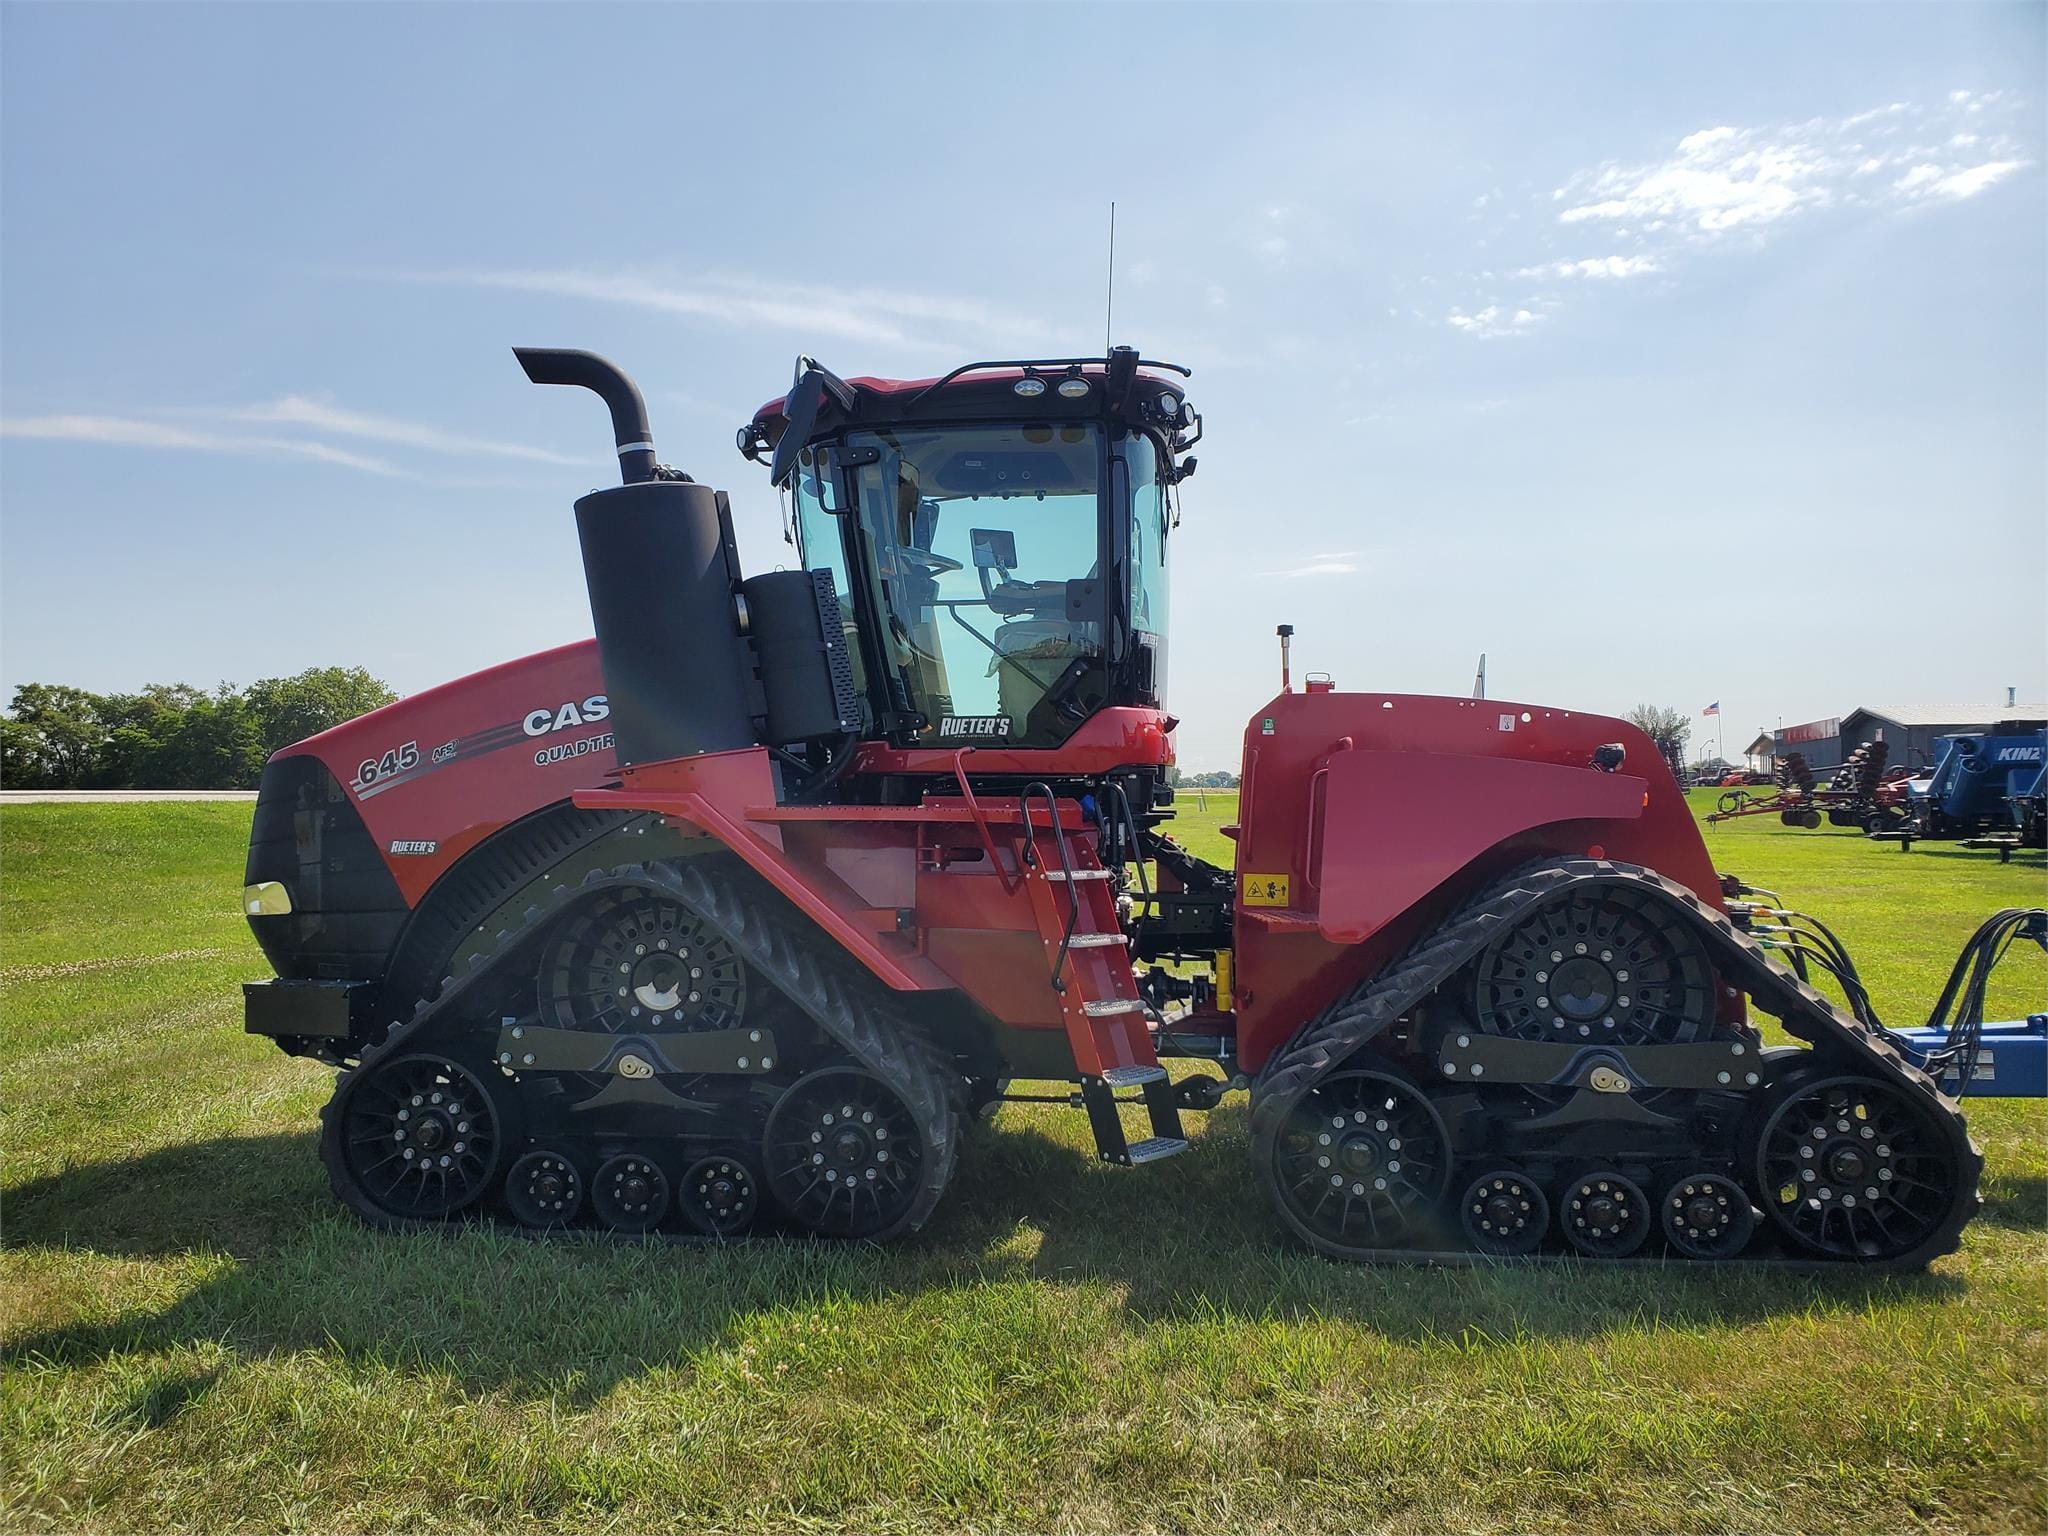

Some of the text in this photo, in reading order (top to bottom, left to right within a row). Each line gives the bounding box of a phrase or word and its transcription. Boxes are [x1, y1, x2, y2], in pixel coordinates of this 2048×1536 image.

[523, 695, 610, 736] CAS
[940, 717, 1010, 736] RUETER'S
[358, 740, 420, 786] 645
[431, 742, 454, 763] AFS
[390, 840, 436, 853] RUETER'S
